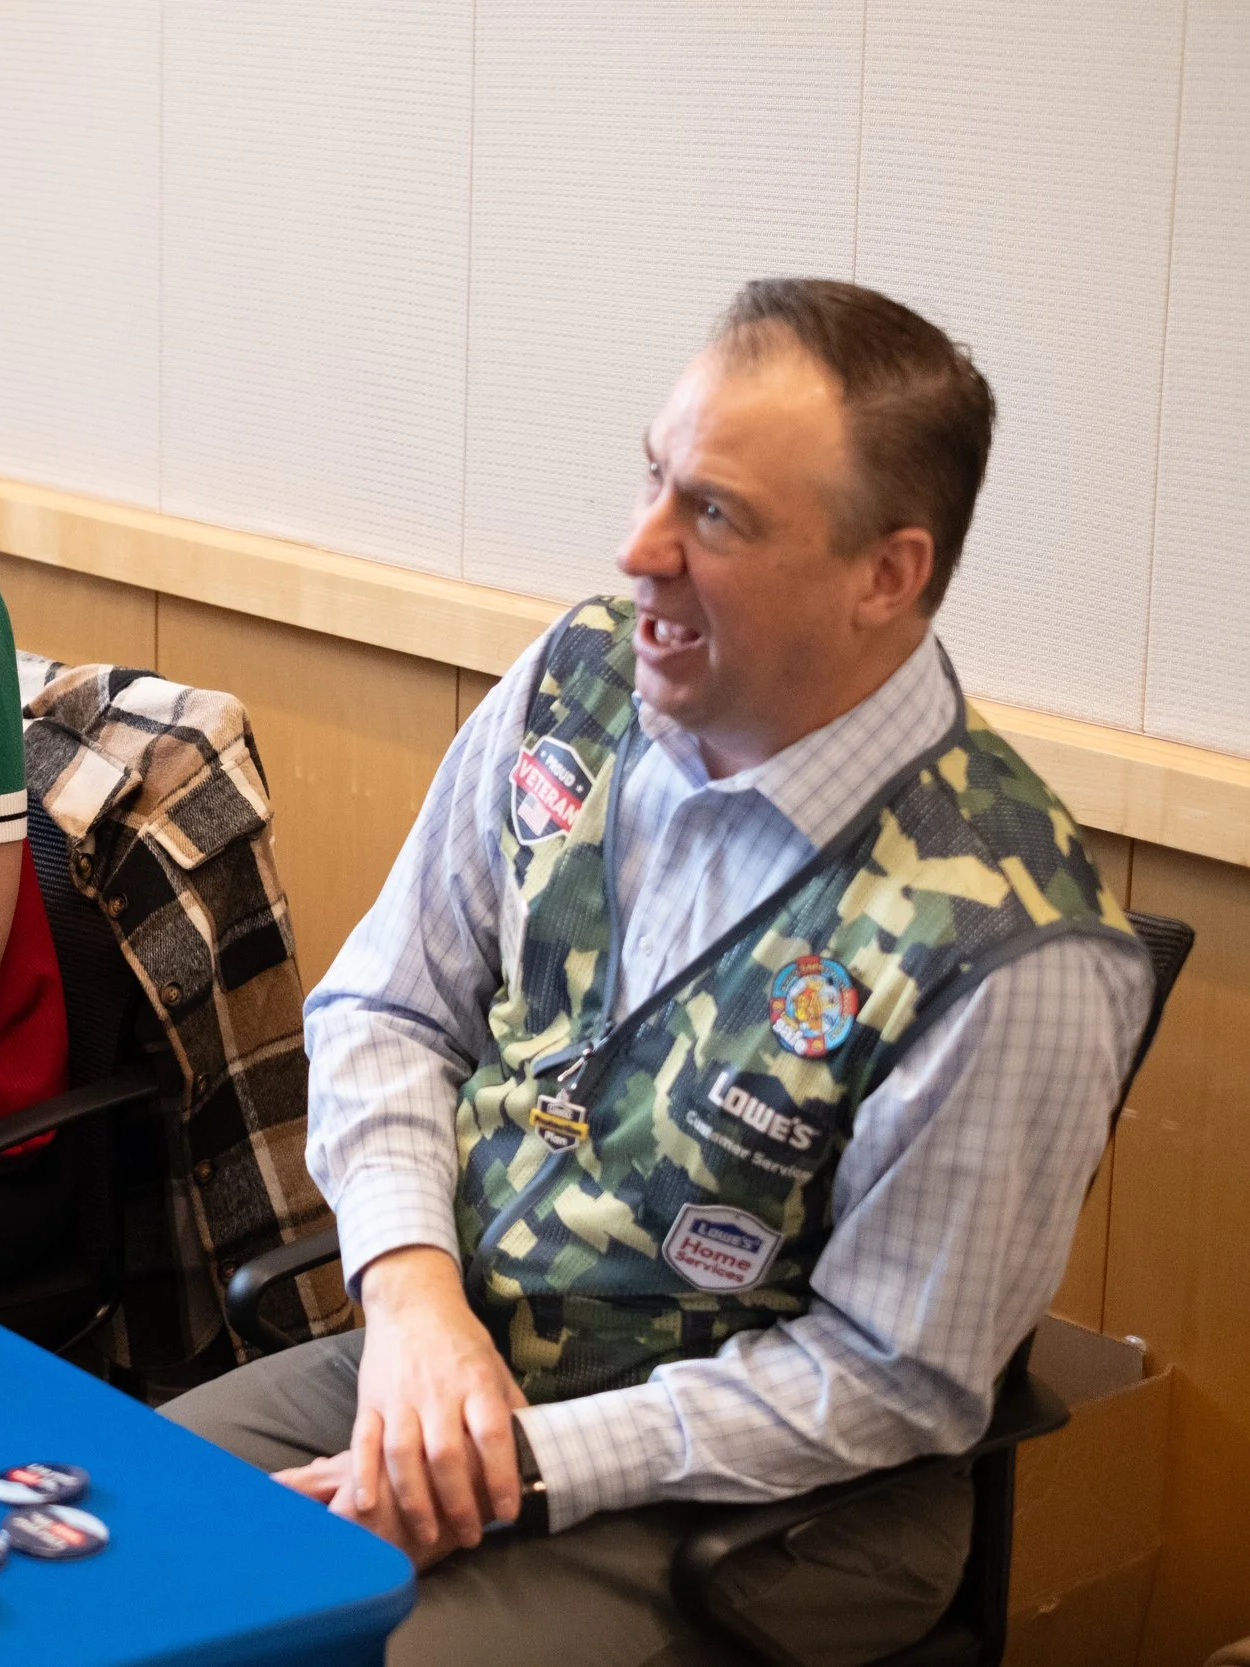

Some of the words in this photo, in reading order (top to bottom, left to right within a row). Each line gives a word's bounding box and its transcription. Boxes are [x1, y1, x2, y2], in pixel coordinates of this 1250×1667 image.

[518, 758, 578, 827] VETERAN
[544, 753, 577, 788] PROUD
[707, 1070, 814, 1150] LOWE'S
[686, 1109, 750, 1159] Customer
[750, 1151, 813, 1181] Service
[675, 1249, 745, 1283] Services
[680, 1236, 751, 1271] Home
